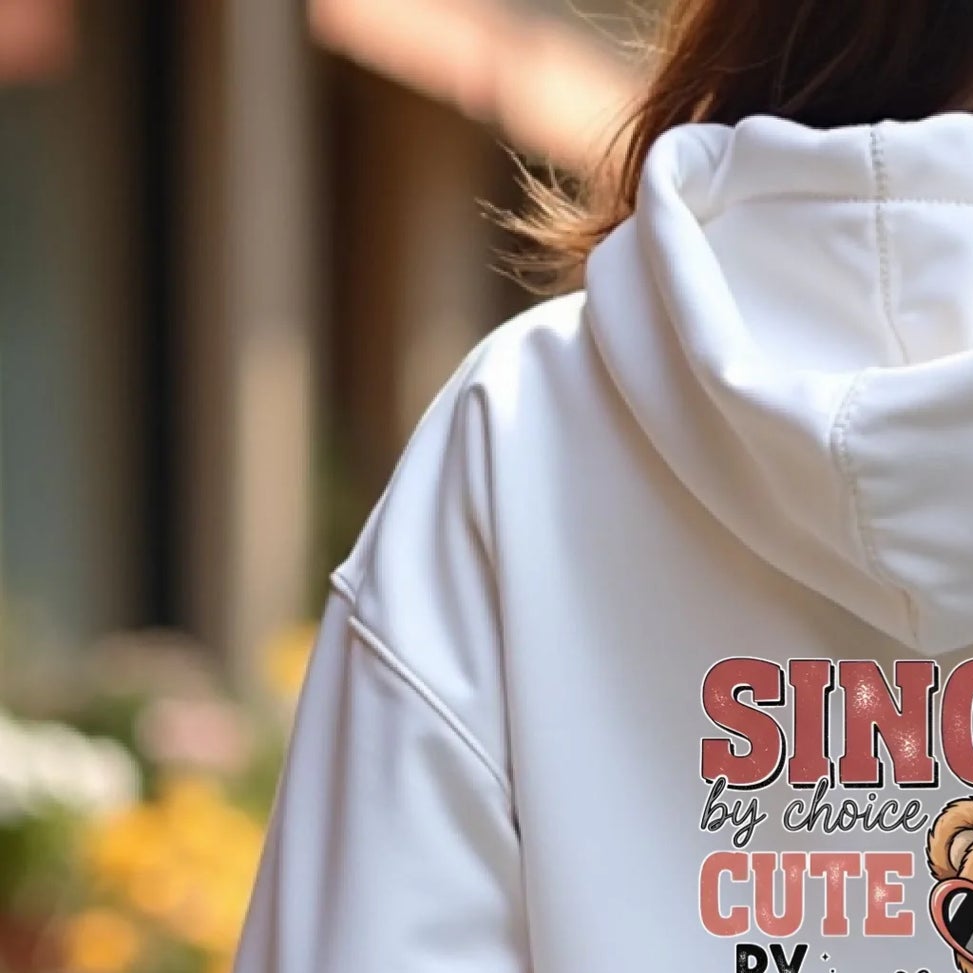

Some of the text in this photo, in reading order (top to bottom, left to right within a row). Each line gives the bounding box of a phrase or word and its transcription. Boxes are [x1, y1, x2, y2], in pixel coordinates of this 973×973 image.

[699, 776, 928, 847] by choice
[700, 851, 915, 938] CUTE
